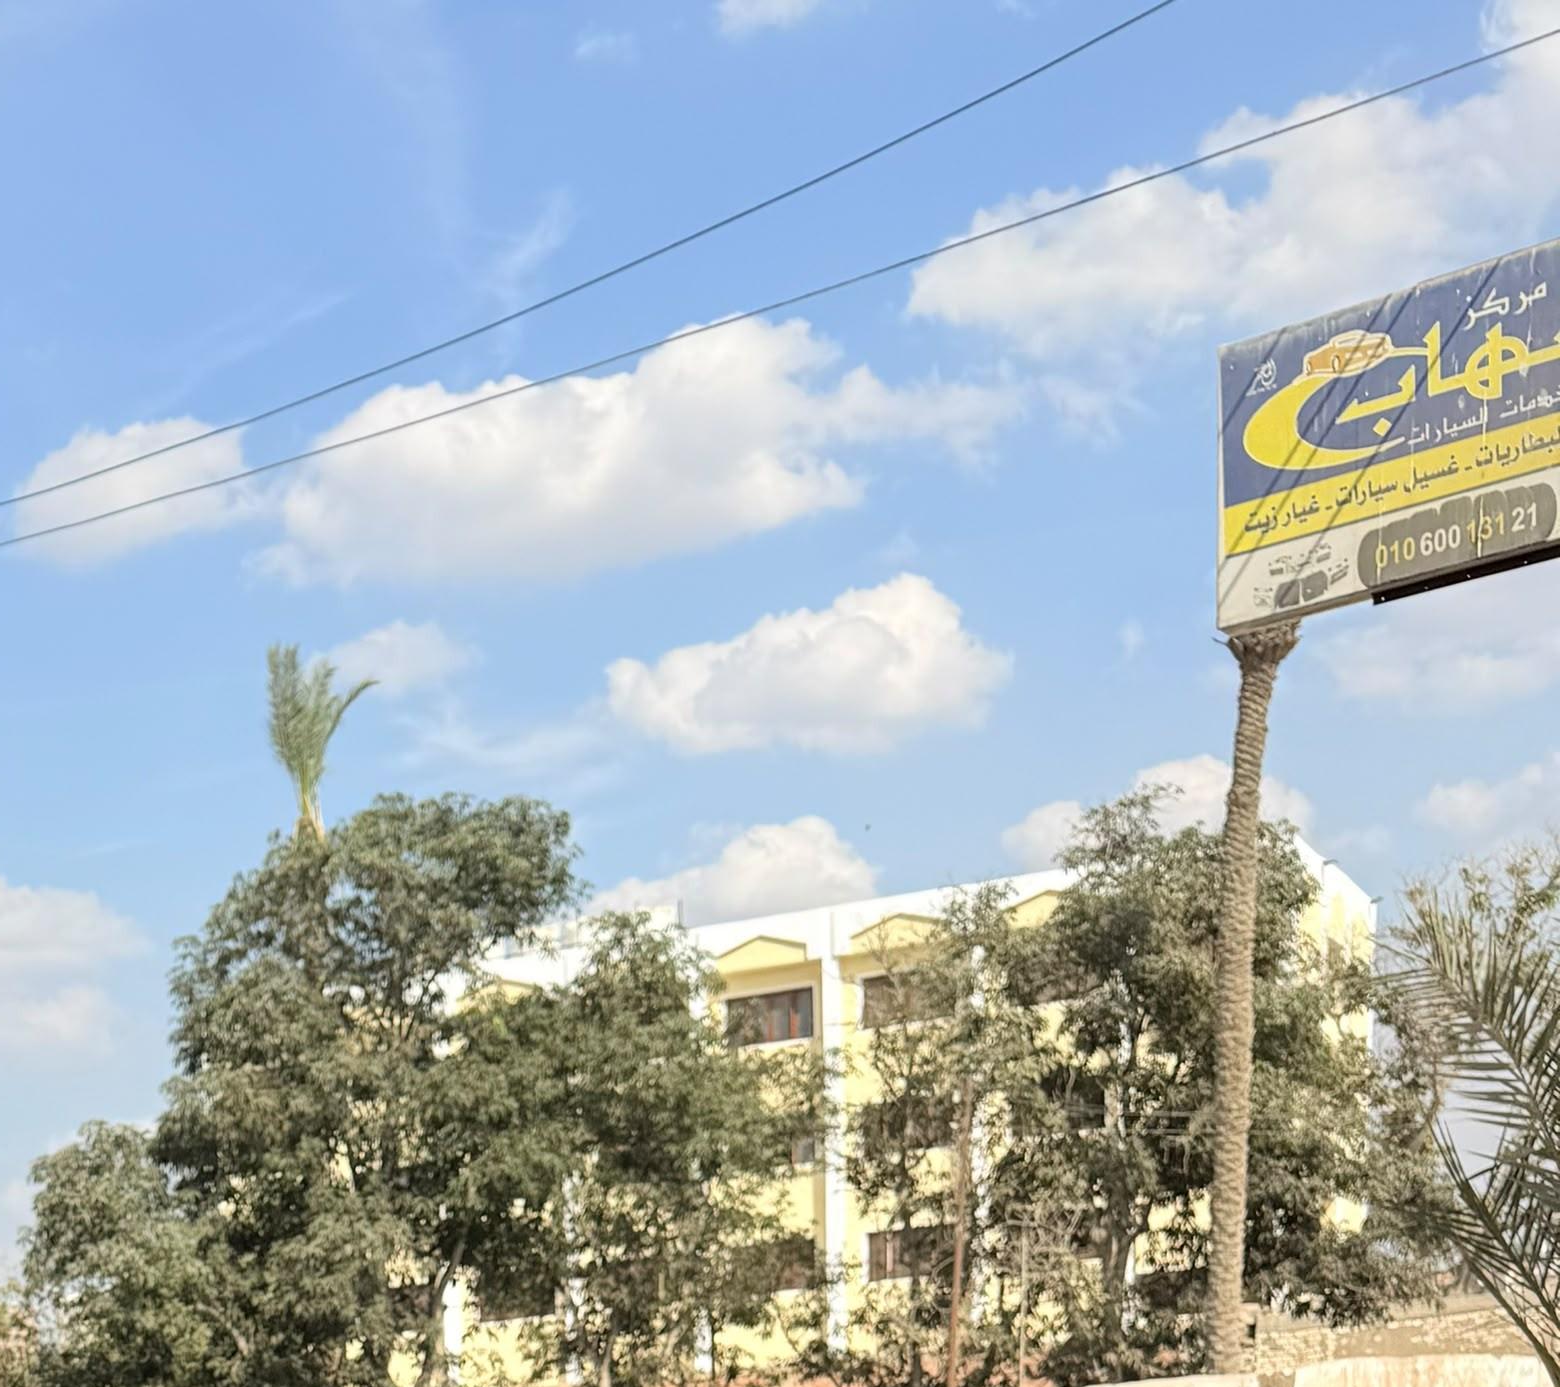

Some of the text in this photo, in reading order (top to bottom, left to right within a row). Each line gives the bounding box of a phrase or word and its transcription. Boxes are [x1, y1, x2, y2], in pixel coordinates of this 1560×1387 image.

[1462, 282, 1548, 331] مركز
[1407, 406, 1488, 445] السيارات
[1403, 454, 1459, 493] غسيل
[1281, 494, 1320, 527] غيار
[1335, 479, 1399, 508] سيارات
[1243, 506, 1279, 535] زيت
[1376, 537, 1415, 568] 010
[1420, 525, 1461, 556] 600
[1511, 502, 1537, 533] 21
